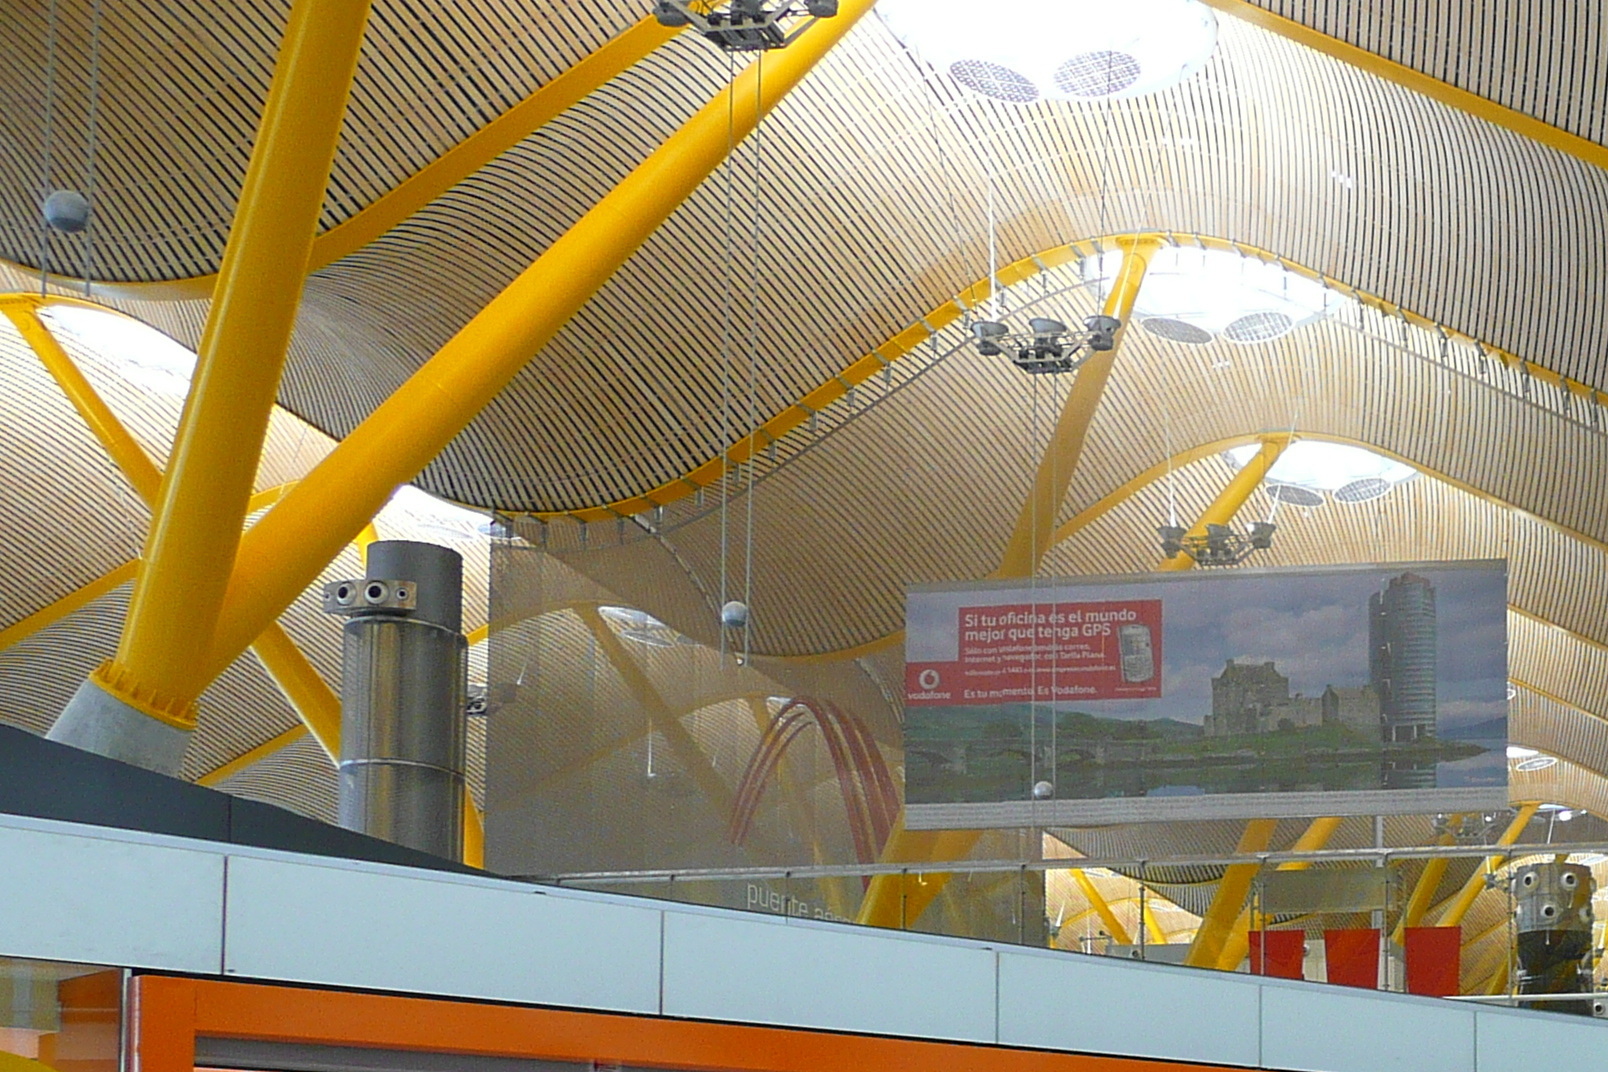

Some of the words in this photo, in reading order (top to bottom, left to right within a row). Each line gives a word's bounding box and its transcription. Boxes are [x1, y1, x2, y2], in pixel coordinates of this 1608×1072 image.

[965, 614, 978, 628] Si
[981, 614, 996, 626] tu
[999, 611, 1045, 626] oficina
[1049, 613, 1065, 624] es
[1069, 610, 1082, 623] el
[1085, 609, 1136, 622] mundo
[965, 628, 1005, 643] mejor
[1008, 629, 1035, 641] que
[1038, 626, 1078, 641] tenga
[1082, 622, 1111, 636] GPS
[908, 691, 951, 700] vodafone
[964, 690, 976, 698] Es
[978, 690, 988, 698] tu
[1038, 687, 1049, 695] Es
[747, 882, 809, 916] puente
